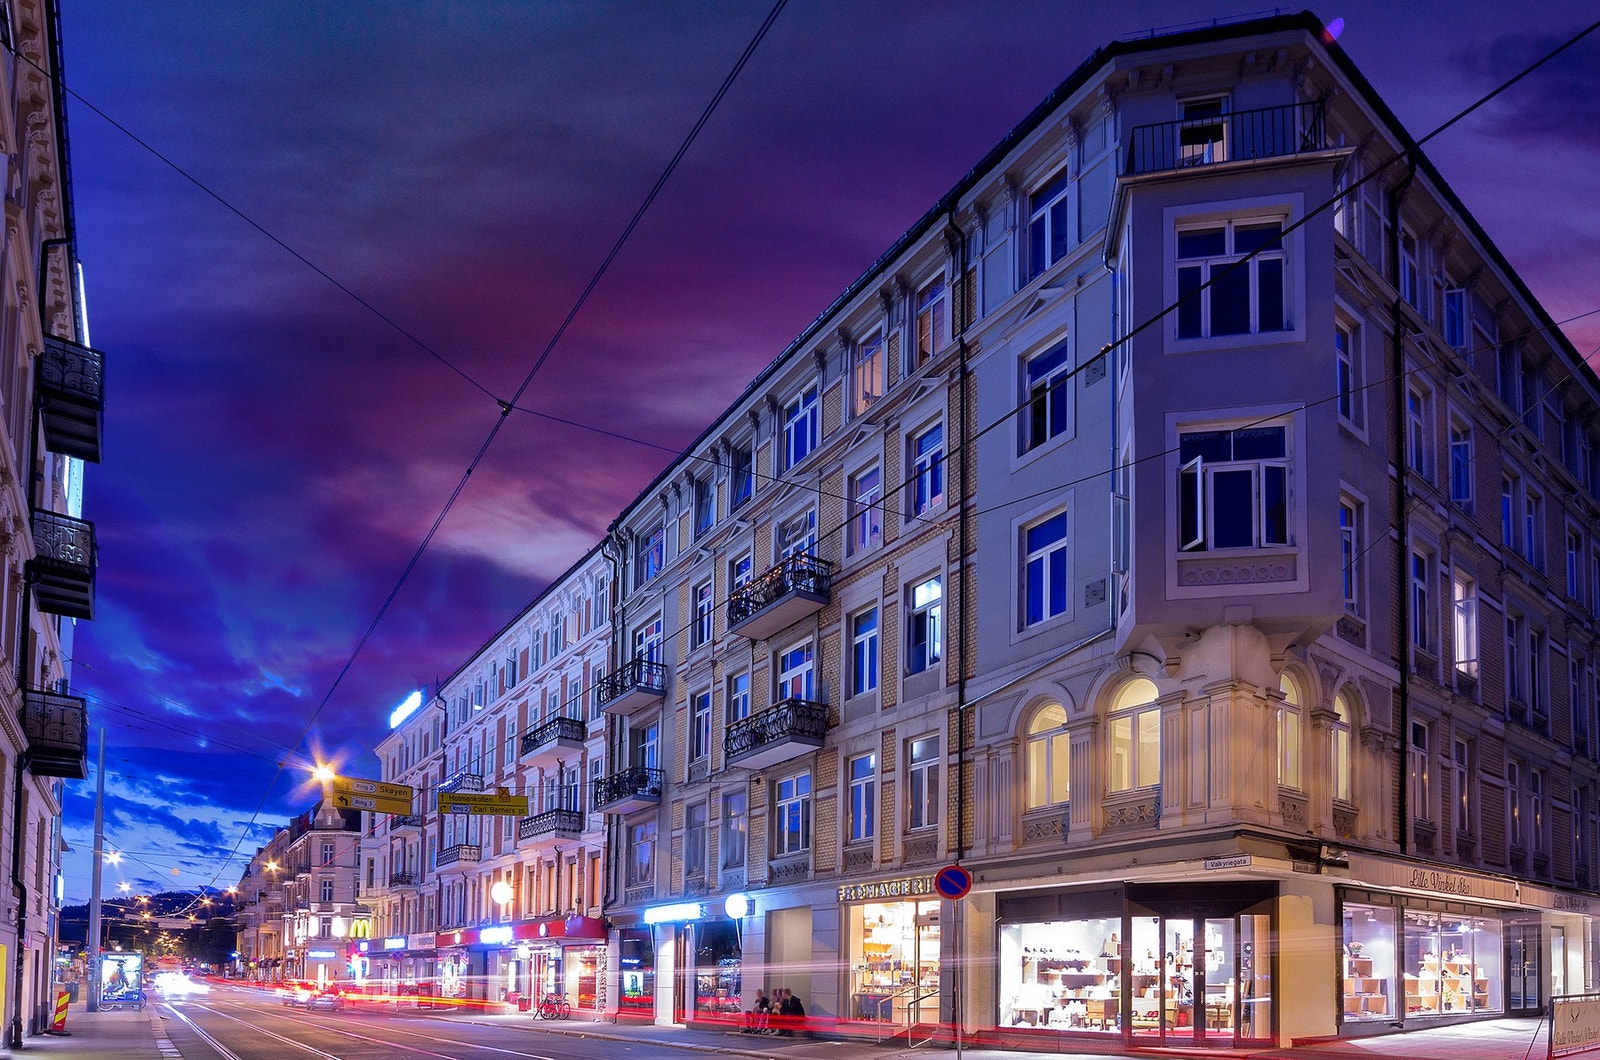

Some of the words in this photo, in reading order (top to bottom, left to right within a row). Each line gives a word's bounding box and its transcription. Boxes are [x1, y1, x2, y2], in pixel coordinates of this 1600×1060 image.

[355, 783, 369, 791] Ring
[380, 786, 408, 796] Skøyen
[354, 799, 368, 807] Ring
[449, 795, 494, 803] Holmenkollen
[1210, 858, 1247, 868] Valkyriegata
[1409, 869, 1428, 888] Lille
[1430, 872, 1456, 892] Vinkel
[1457, 877, 1470, 894] Sko
[837, 877, 936, 901] FROMAGERI
